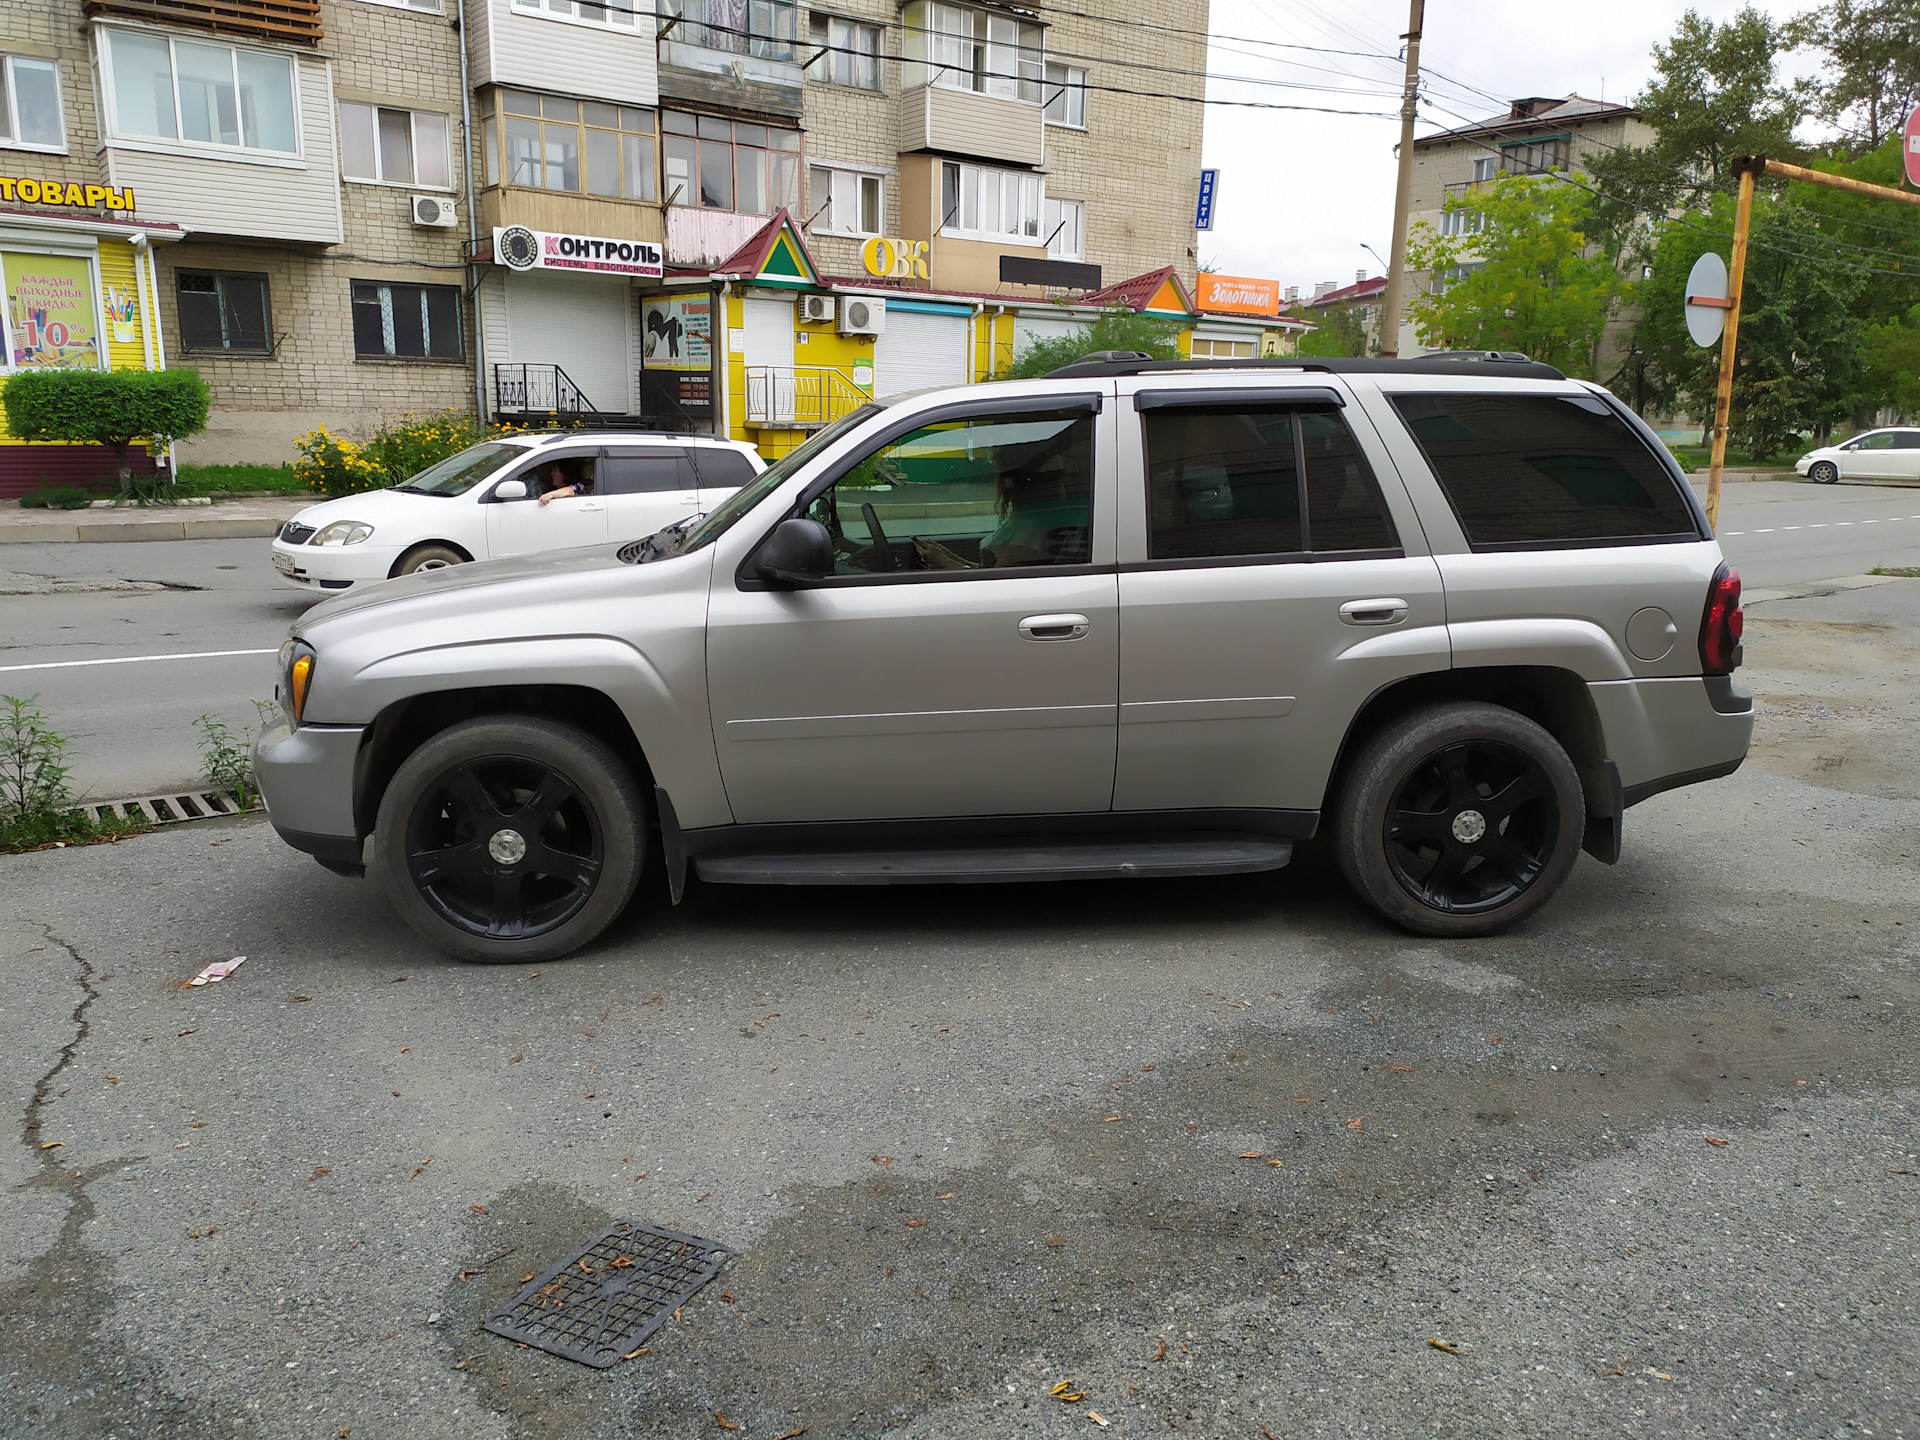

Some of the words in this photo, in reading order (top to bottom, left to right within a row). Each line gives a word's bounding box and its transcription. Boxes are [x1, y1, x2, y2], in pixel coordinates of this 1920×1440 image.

[0, 177, 135, 211] ТОВАРЫ
[1197, 173, 1212, 227] ЦВЕТЫ
[545, 236, 660, 263] КОНТРОЛЬ
[861, 237, 930, 280] ОВК
[544, 258, 588, 269] СИСТЕМЫ
[594, 263, 661, 276] БЕЗОПАСНОСТИ
[21, 275, 76, 287] КАЖДЫЕ
[15, 286, 84, 299] ВЫХОДНЫЕ
[27, 298, 76, 310] СКИДКА
